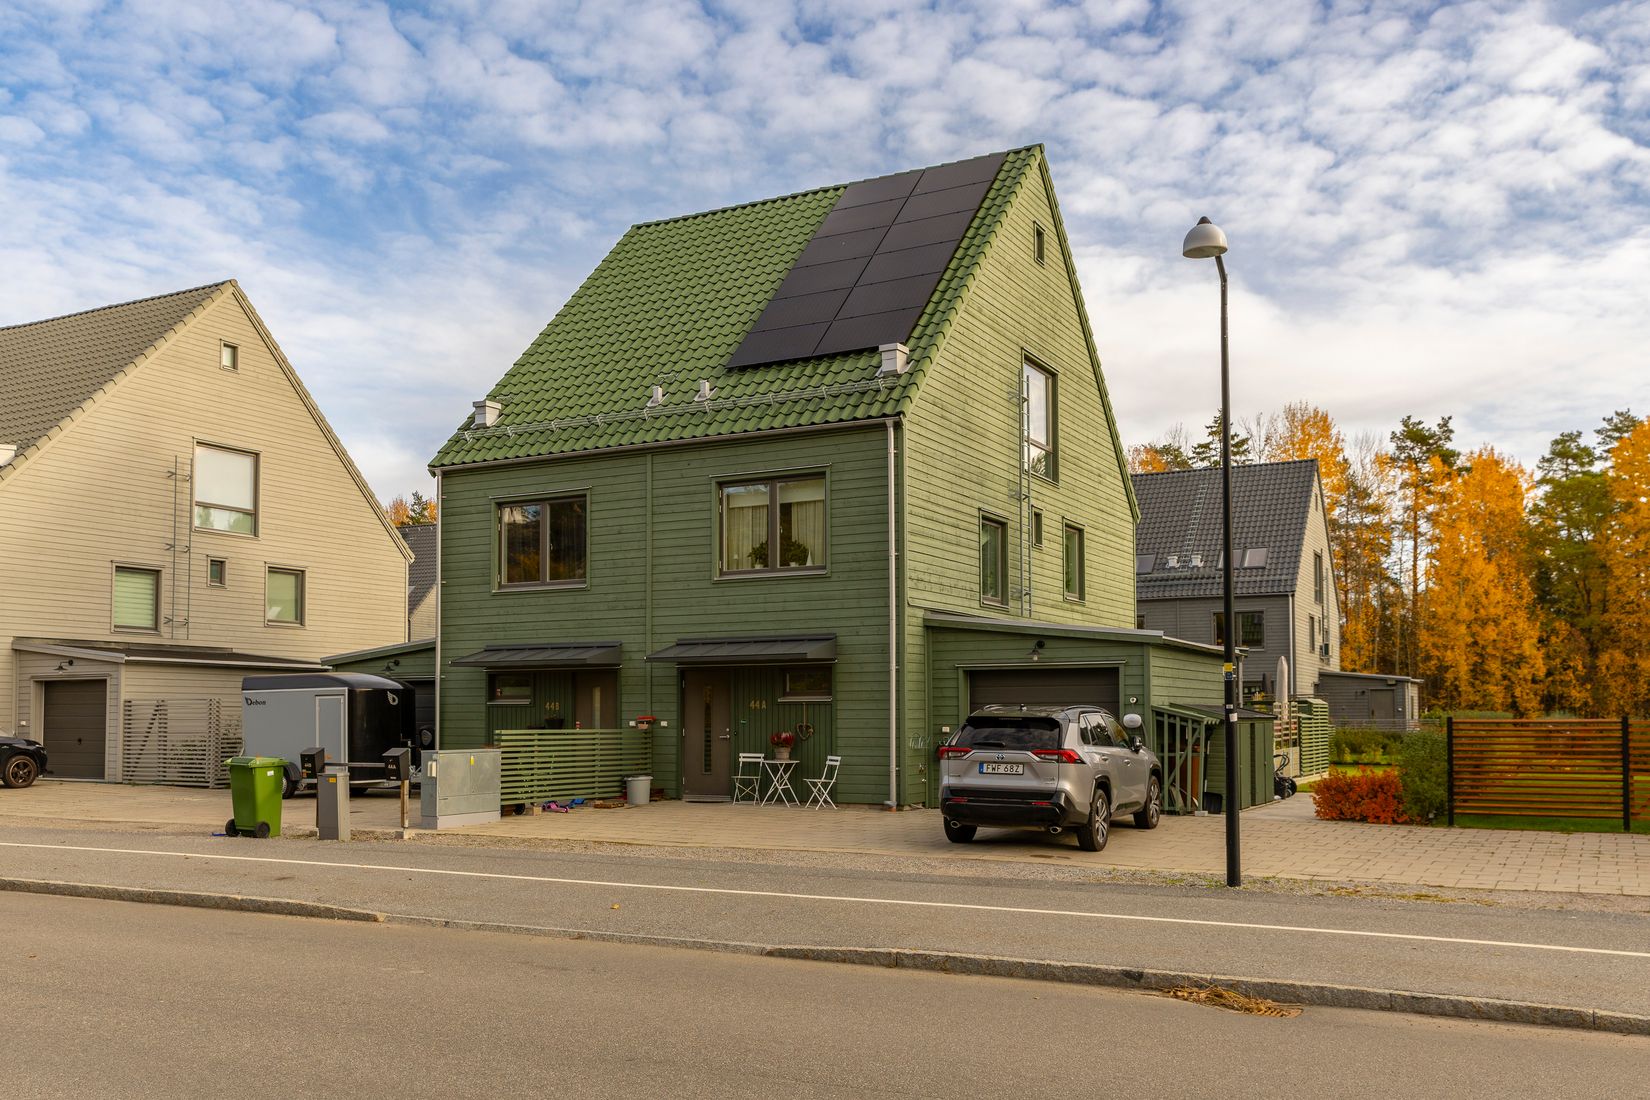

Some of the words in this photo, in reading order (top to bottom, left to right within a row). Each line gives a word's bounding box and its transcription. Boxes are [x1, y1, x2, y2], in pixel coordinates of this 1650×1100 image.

[245, 696, 266, 706] Debon
[750, 700, 767, 710] 44A
[986, 764, 1001, 772] FWF
[1004, 764, 1020, 773] 68Z
